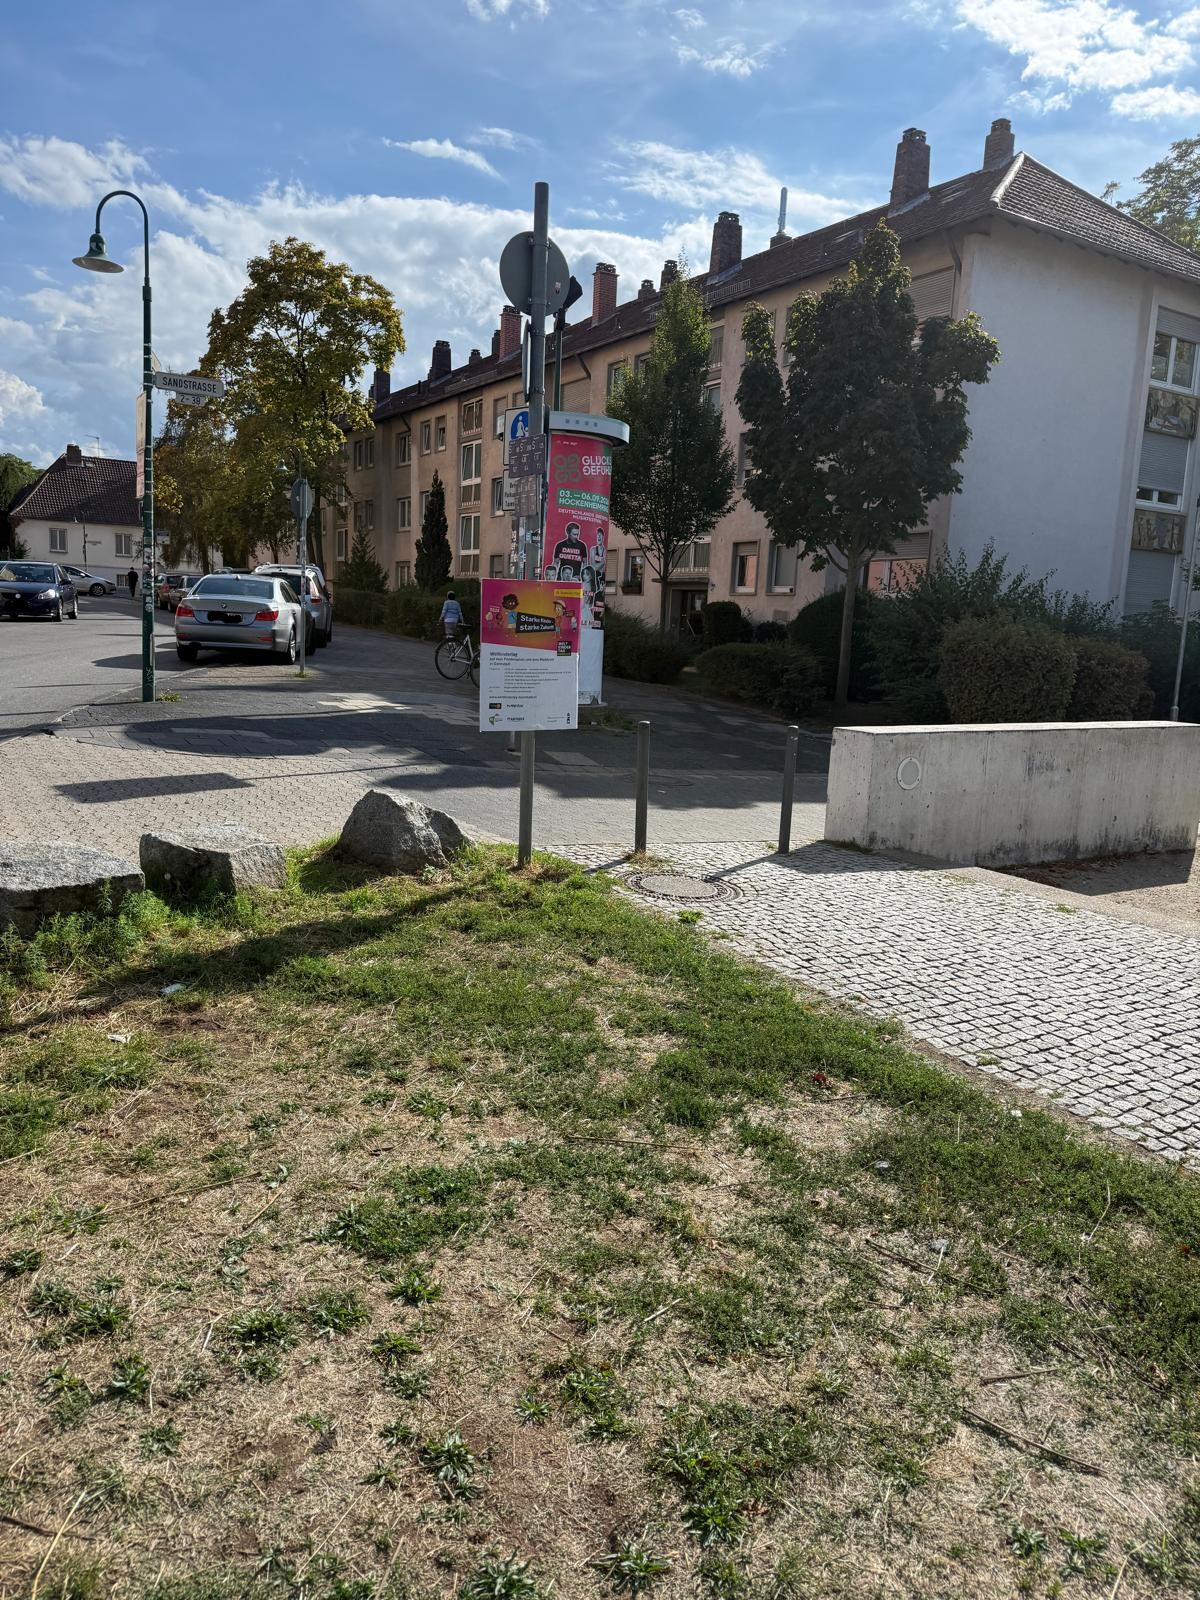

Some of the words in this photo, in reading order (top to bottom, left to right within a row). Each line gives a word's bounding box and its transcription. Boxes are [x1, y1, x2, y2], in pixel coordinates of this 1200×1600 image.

[162, 376, 217, 394] SANDSTRASSE
[560, 490, 572, 498] 03.
[559, 553, 582, 561] GUETTA
[520, 614, 540, 623] Starke
[520, 623, 540, 631] starke
